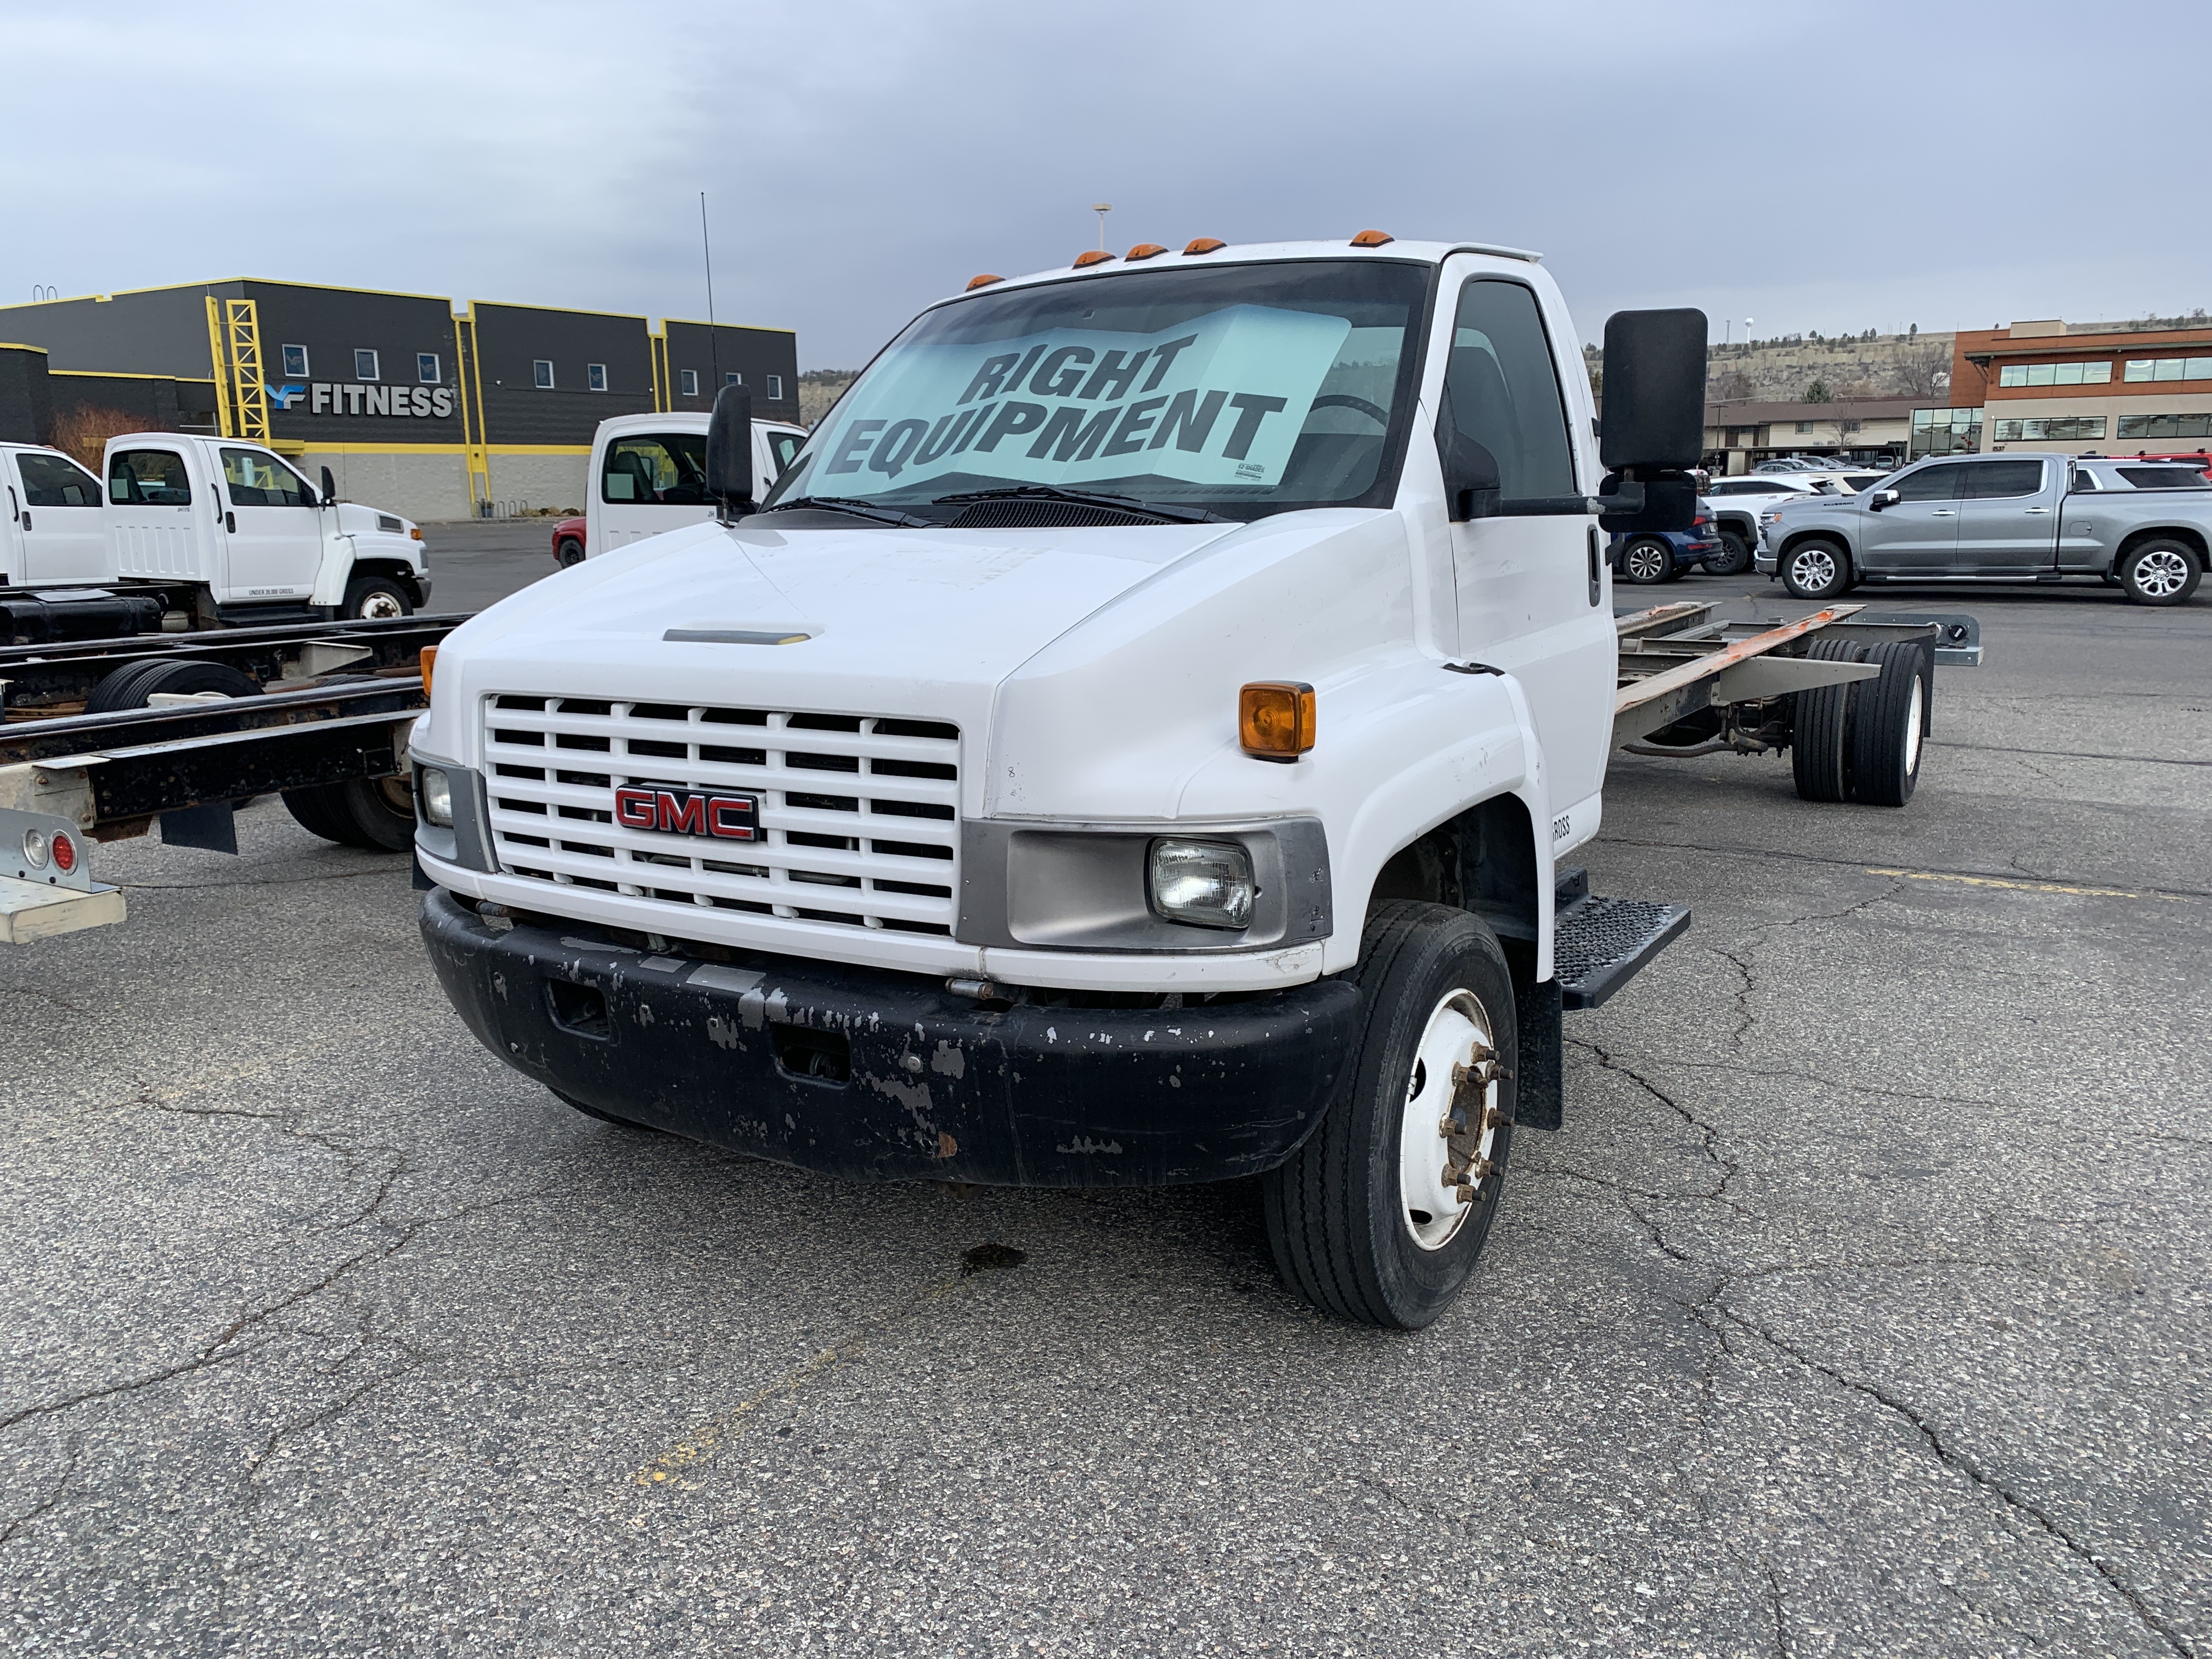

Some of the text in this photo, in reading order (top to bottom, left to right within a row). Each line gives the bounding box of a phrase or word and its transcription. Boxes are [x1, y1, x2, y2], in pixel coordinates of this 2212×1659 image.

[312, 383, 452, 417] FITNESS
[957, 333, 1198, 405] RIGHT
[825, 389, 1288, 479] EQUIPMENT
[616, 787, 754, 840] GMC
